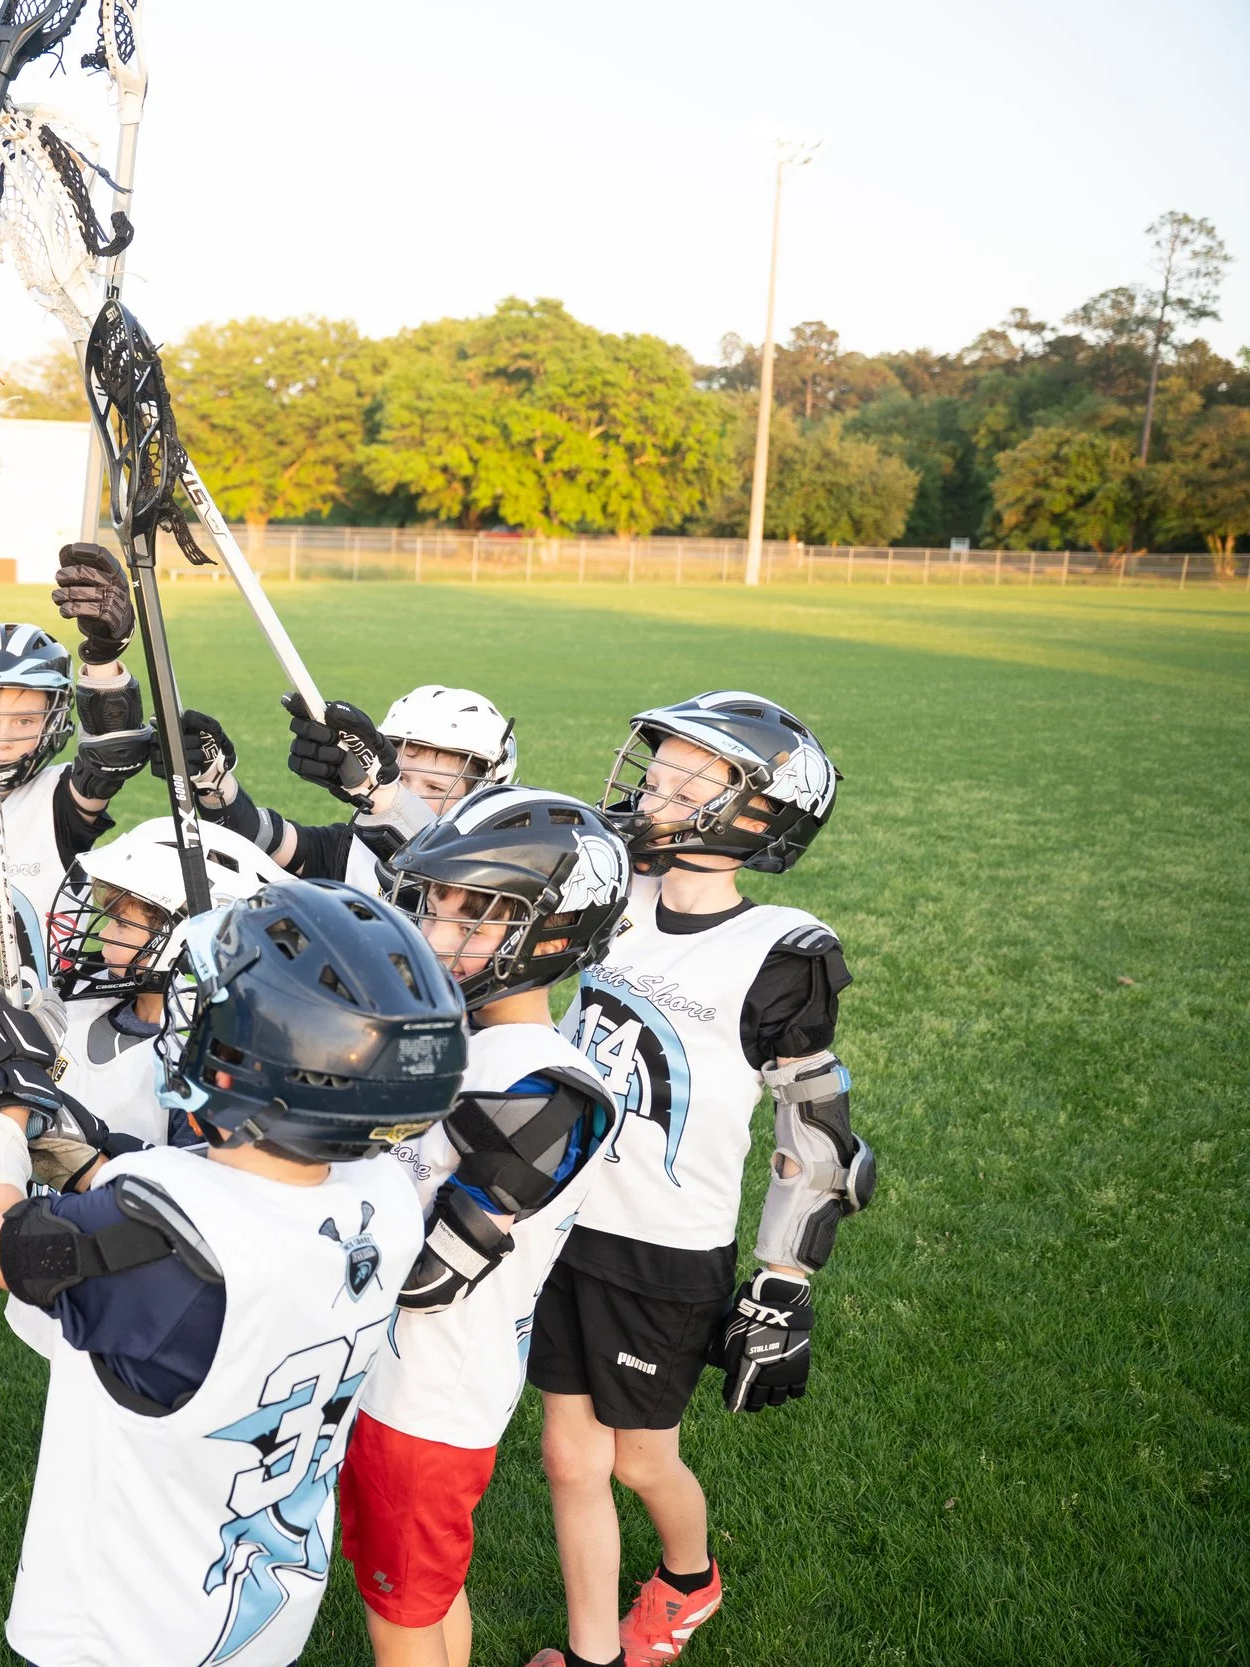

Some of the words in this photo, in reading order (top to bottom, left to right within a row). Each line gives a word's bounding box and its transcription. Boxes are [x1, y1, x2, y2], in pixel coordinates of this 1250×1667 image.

[100, 762, 142, 772] TRUE
[173, 774, 187, 801] 6000
[178, 806, 200, 849] TX
[628, 975, 717, 1022] Shore
[578, 1003, 643, 1096] 14
[737, 1297, 793, 1327] STX
[749, 1342, 780, 1355] STALLION
[617, 1351, 657, 1376] PUMA
